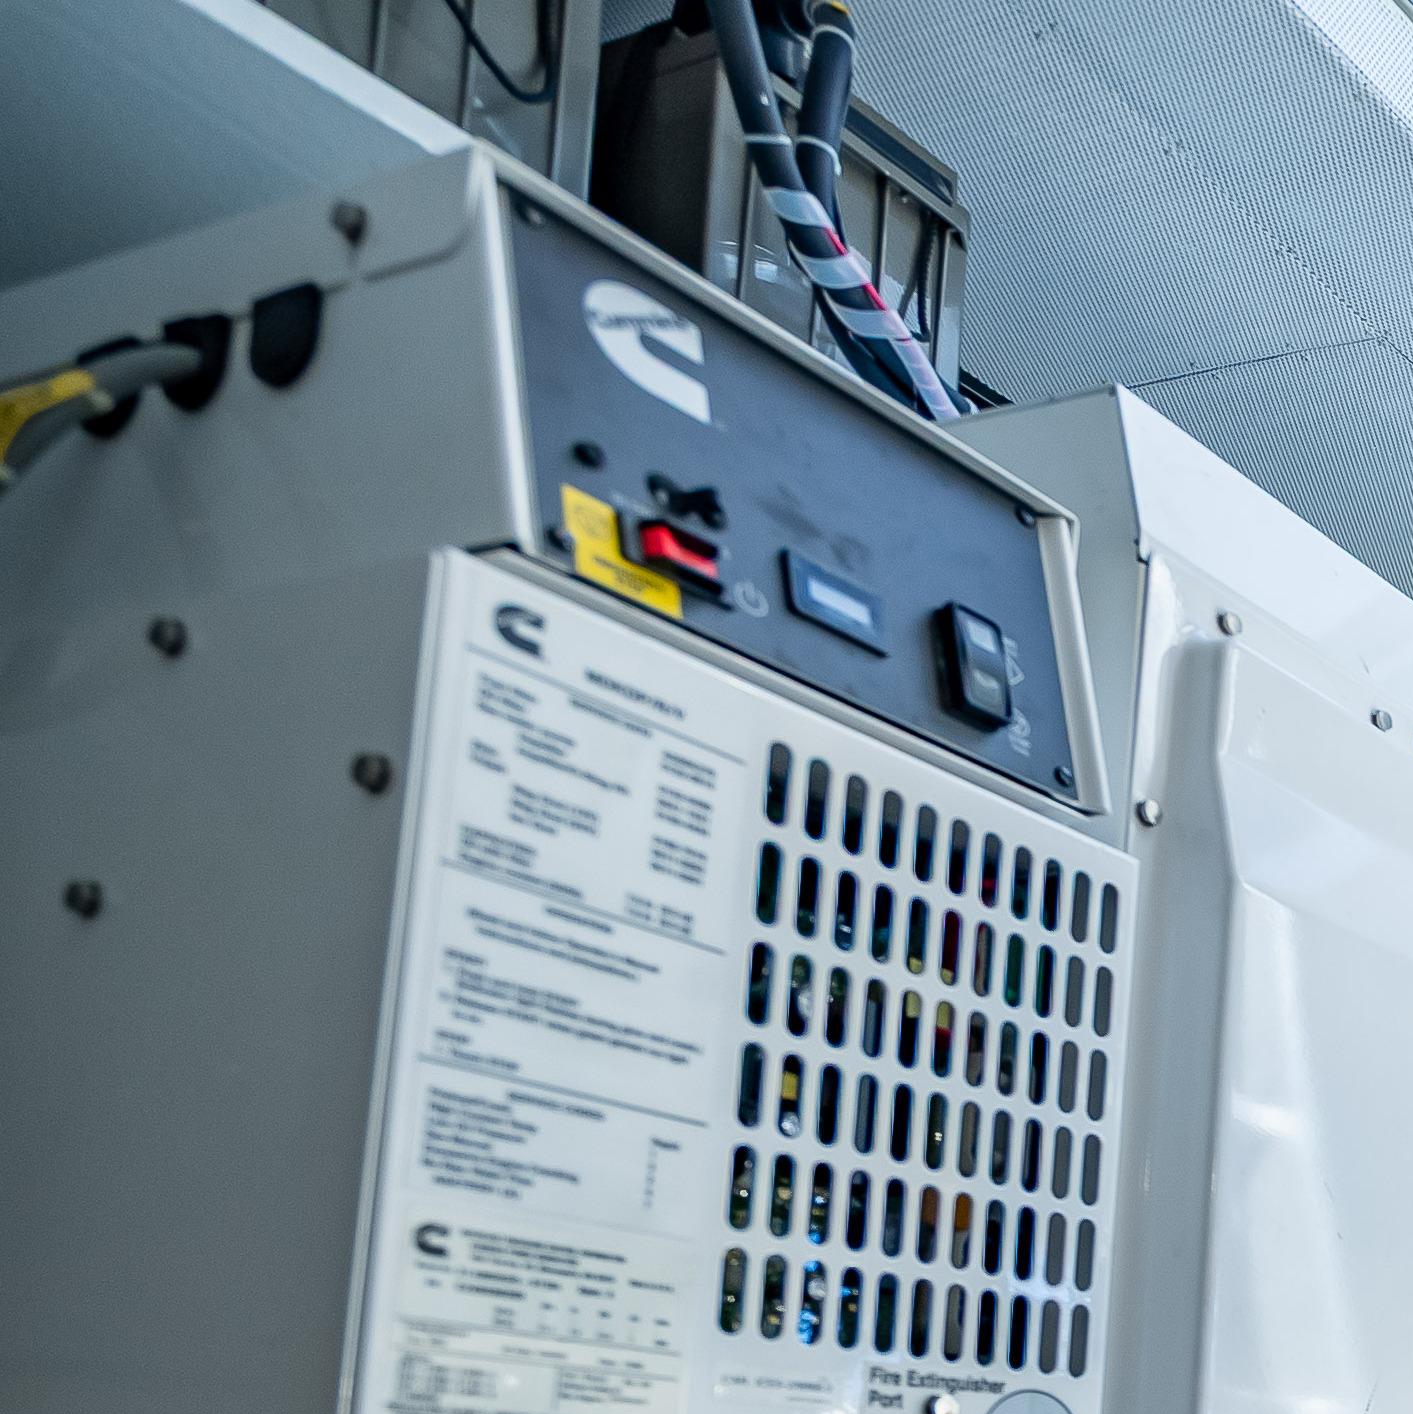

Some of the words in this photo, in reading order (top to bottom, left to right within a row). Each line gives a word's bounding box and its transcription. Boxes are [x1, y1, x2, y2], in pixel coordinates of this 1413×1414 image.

[867, 1366, 901, 1386] Fire
[906, 1369, 1006, 1395] Extinguisher
[867, 1389, 903, 1408] Port
